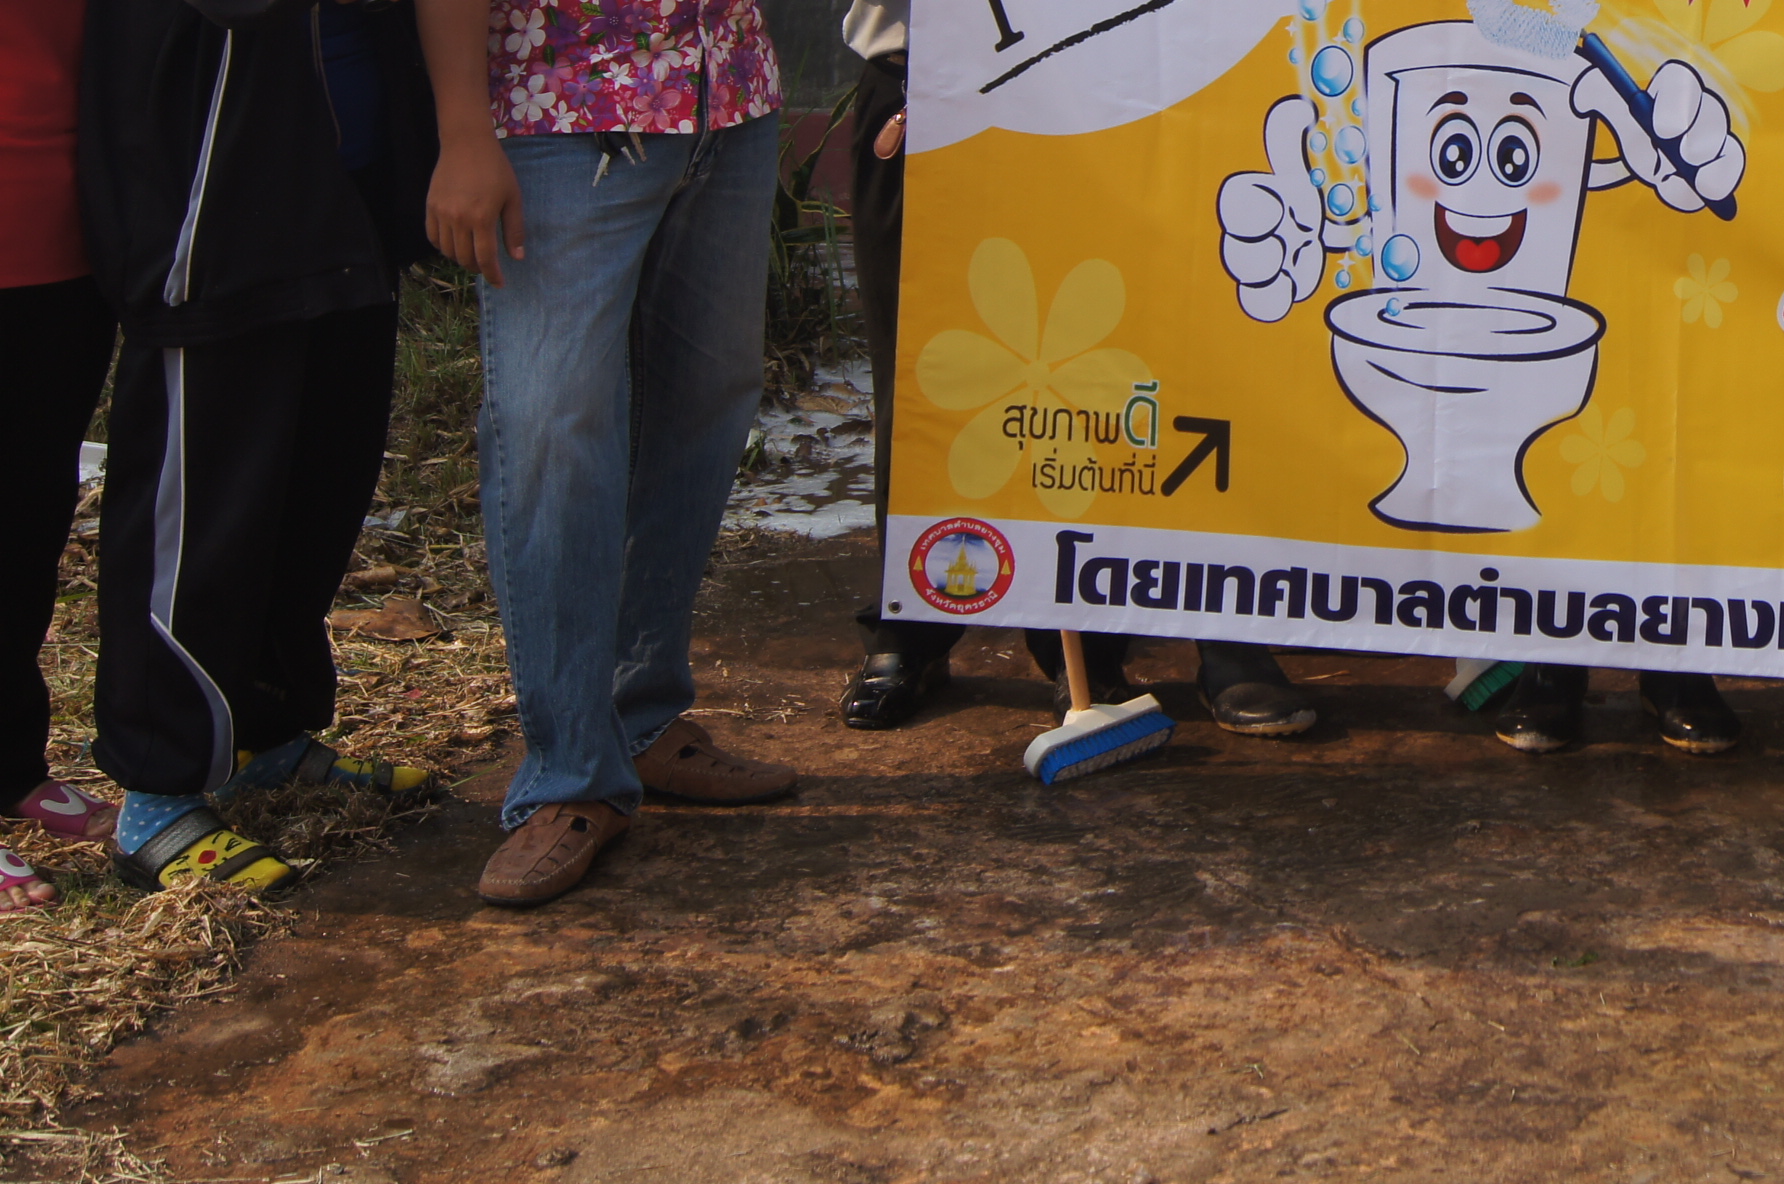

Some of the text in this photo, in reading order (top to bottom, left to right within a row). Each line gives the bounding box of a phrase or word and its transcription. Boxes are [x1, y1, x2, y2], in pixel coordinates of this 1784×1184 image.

[1002, 380, 1159, 451] สุขภาพดี
[1031, 447, 1157, 496] เริ่มต้นที่นี่
